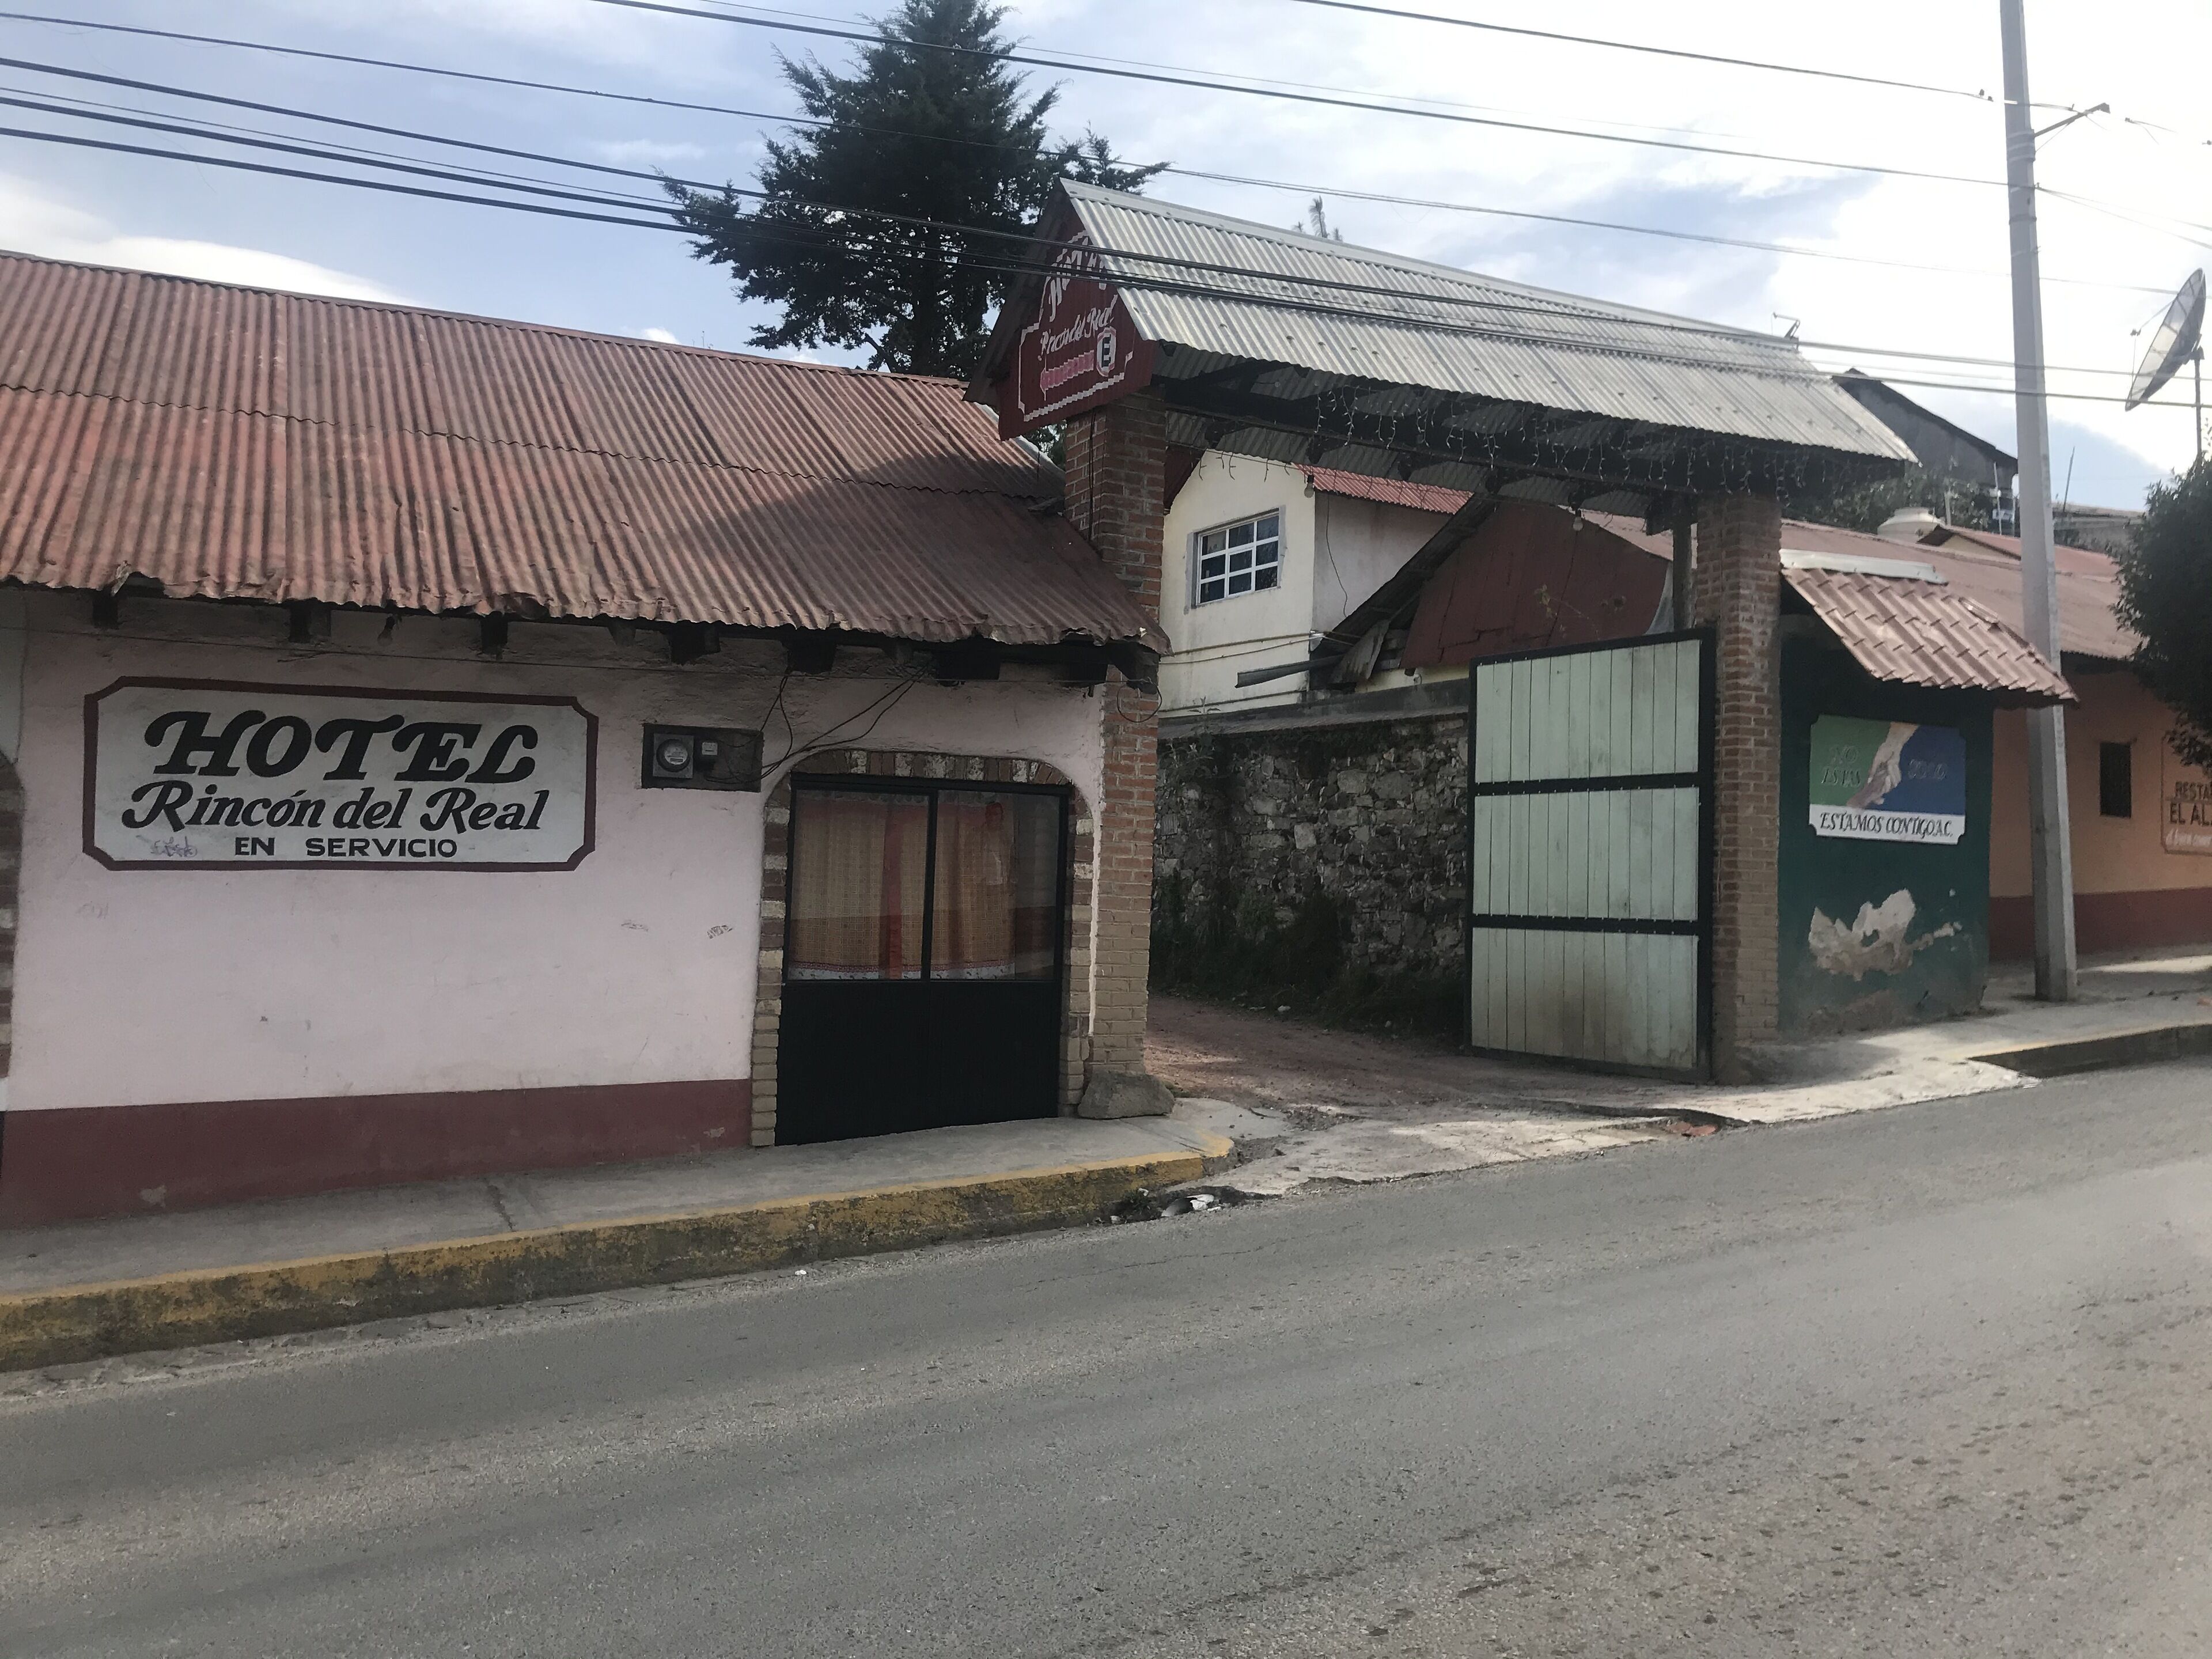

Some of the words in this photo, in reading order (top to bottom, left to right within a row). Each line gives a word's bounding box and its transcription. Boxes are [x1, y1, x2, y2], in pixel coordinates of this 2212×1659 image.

[144, 709, 539, 785] HOTEL
[122, 780, 326, 832] Rincón
[332, 787, 413, 830] del
[419, 787, 550, 834] Real
[2169, 801, 2186, 825] EL
[2190, 801, 2212, 827] AL
[1820, 811, 1884, 834] ESTAMOS
[235, 836, 275, 857] EN
[305, 838, 457, 858] SERVICIO
